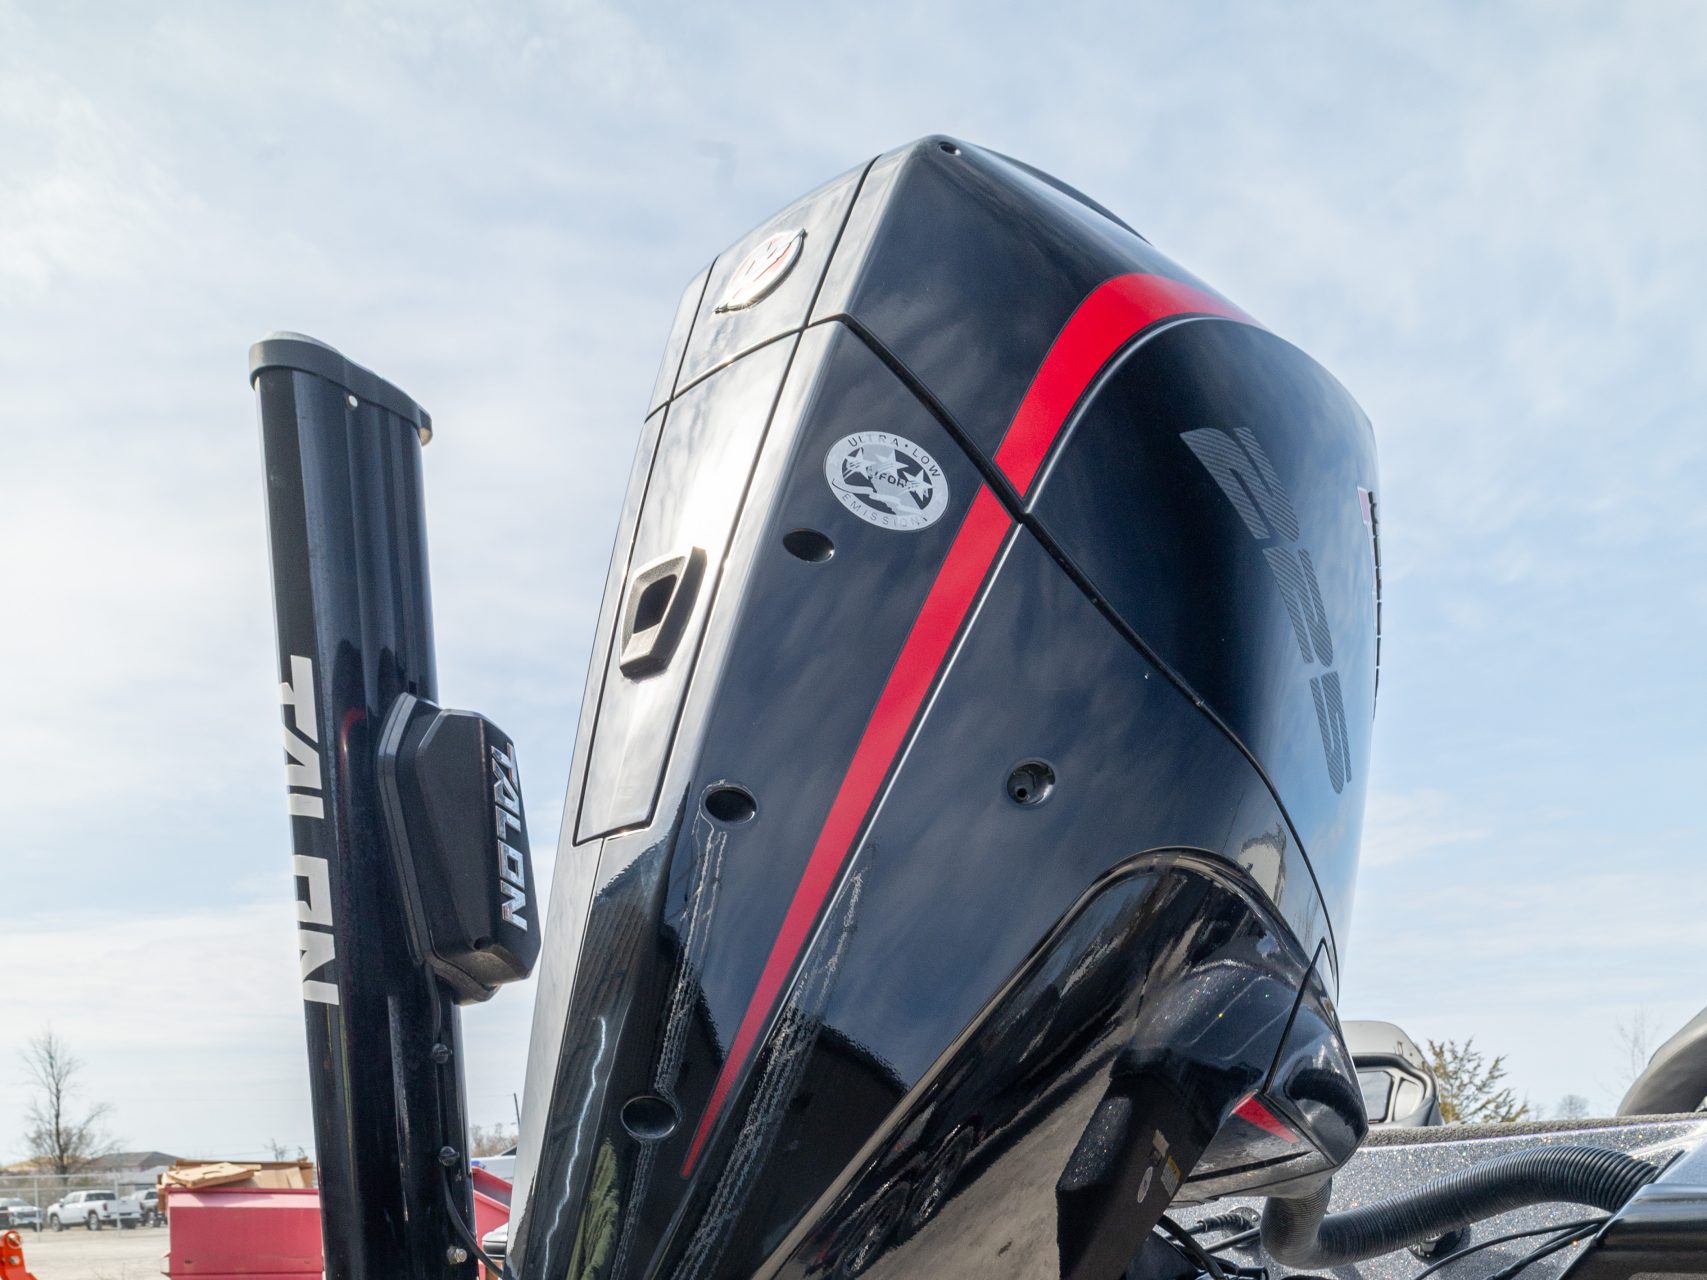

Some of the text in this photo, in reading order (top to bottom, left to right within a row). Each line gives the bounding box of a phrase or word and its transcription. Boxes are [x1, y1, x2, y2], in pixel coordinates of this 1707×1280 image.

[848, 434, 941, 477] ULTRA LOW
[1179, 426, 1351, 794] 225
[278, 654, 340, 1006] TALON
[491, 741, 528, 932] TALON
